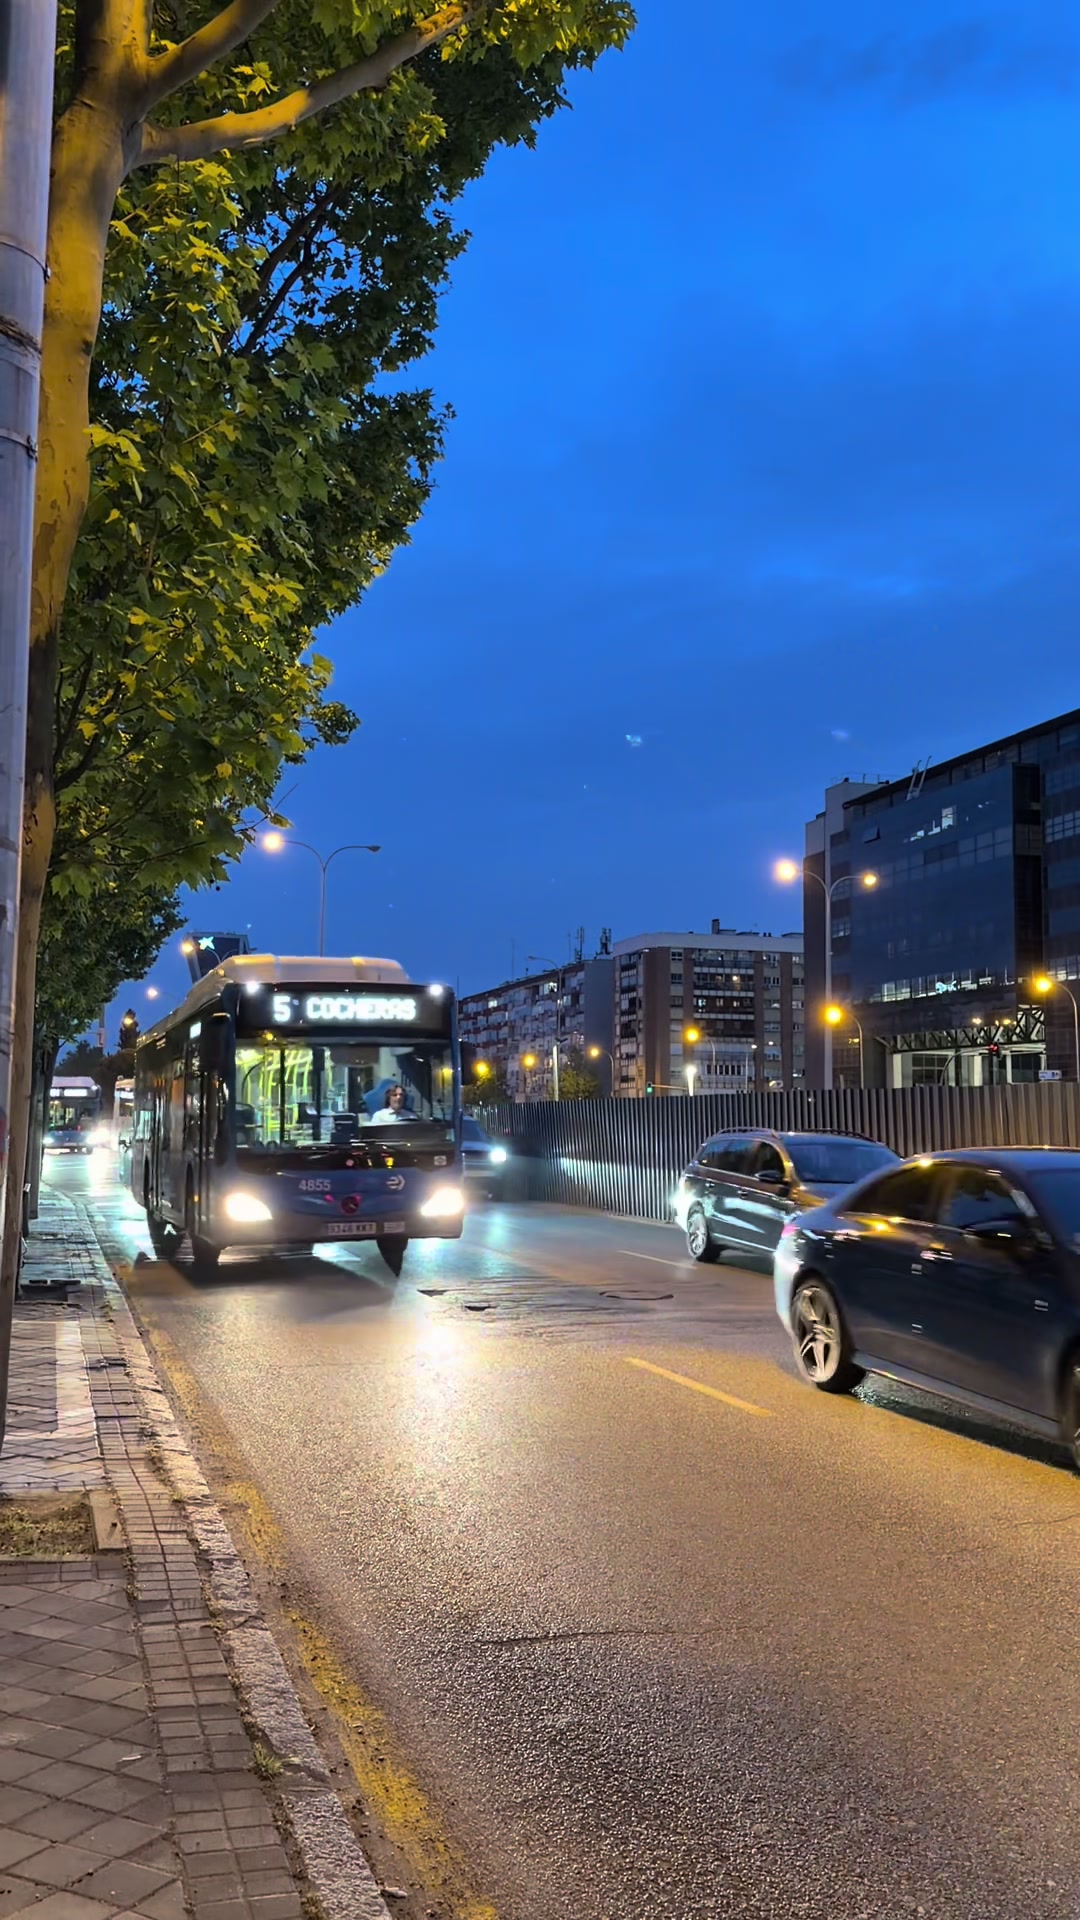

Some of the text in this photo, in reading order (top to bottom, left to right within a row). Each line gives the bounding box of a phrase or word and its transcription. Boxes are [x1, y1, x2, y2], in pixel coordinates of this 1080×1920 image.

[273, 995, 416, 1022] 5 COCHERAS
[298, 1179, 332, 1192] 4855
